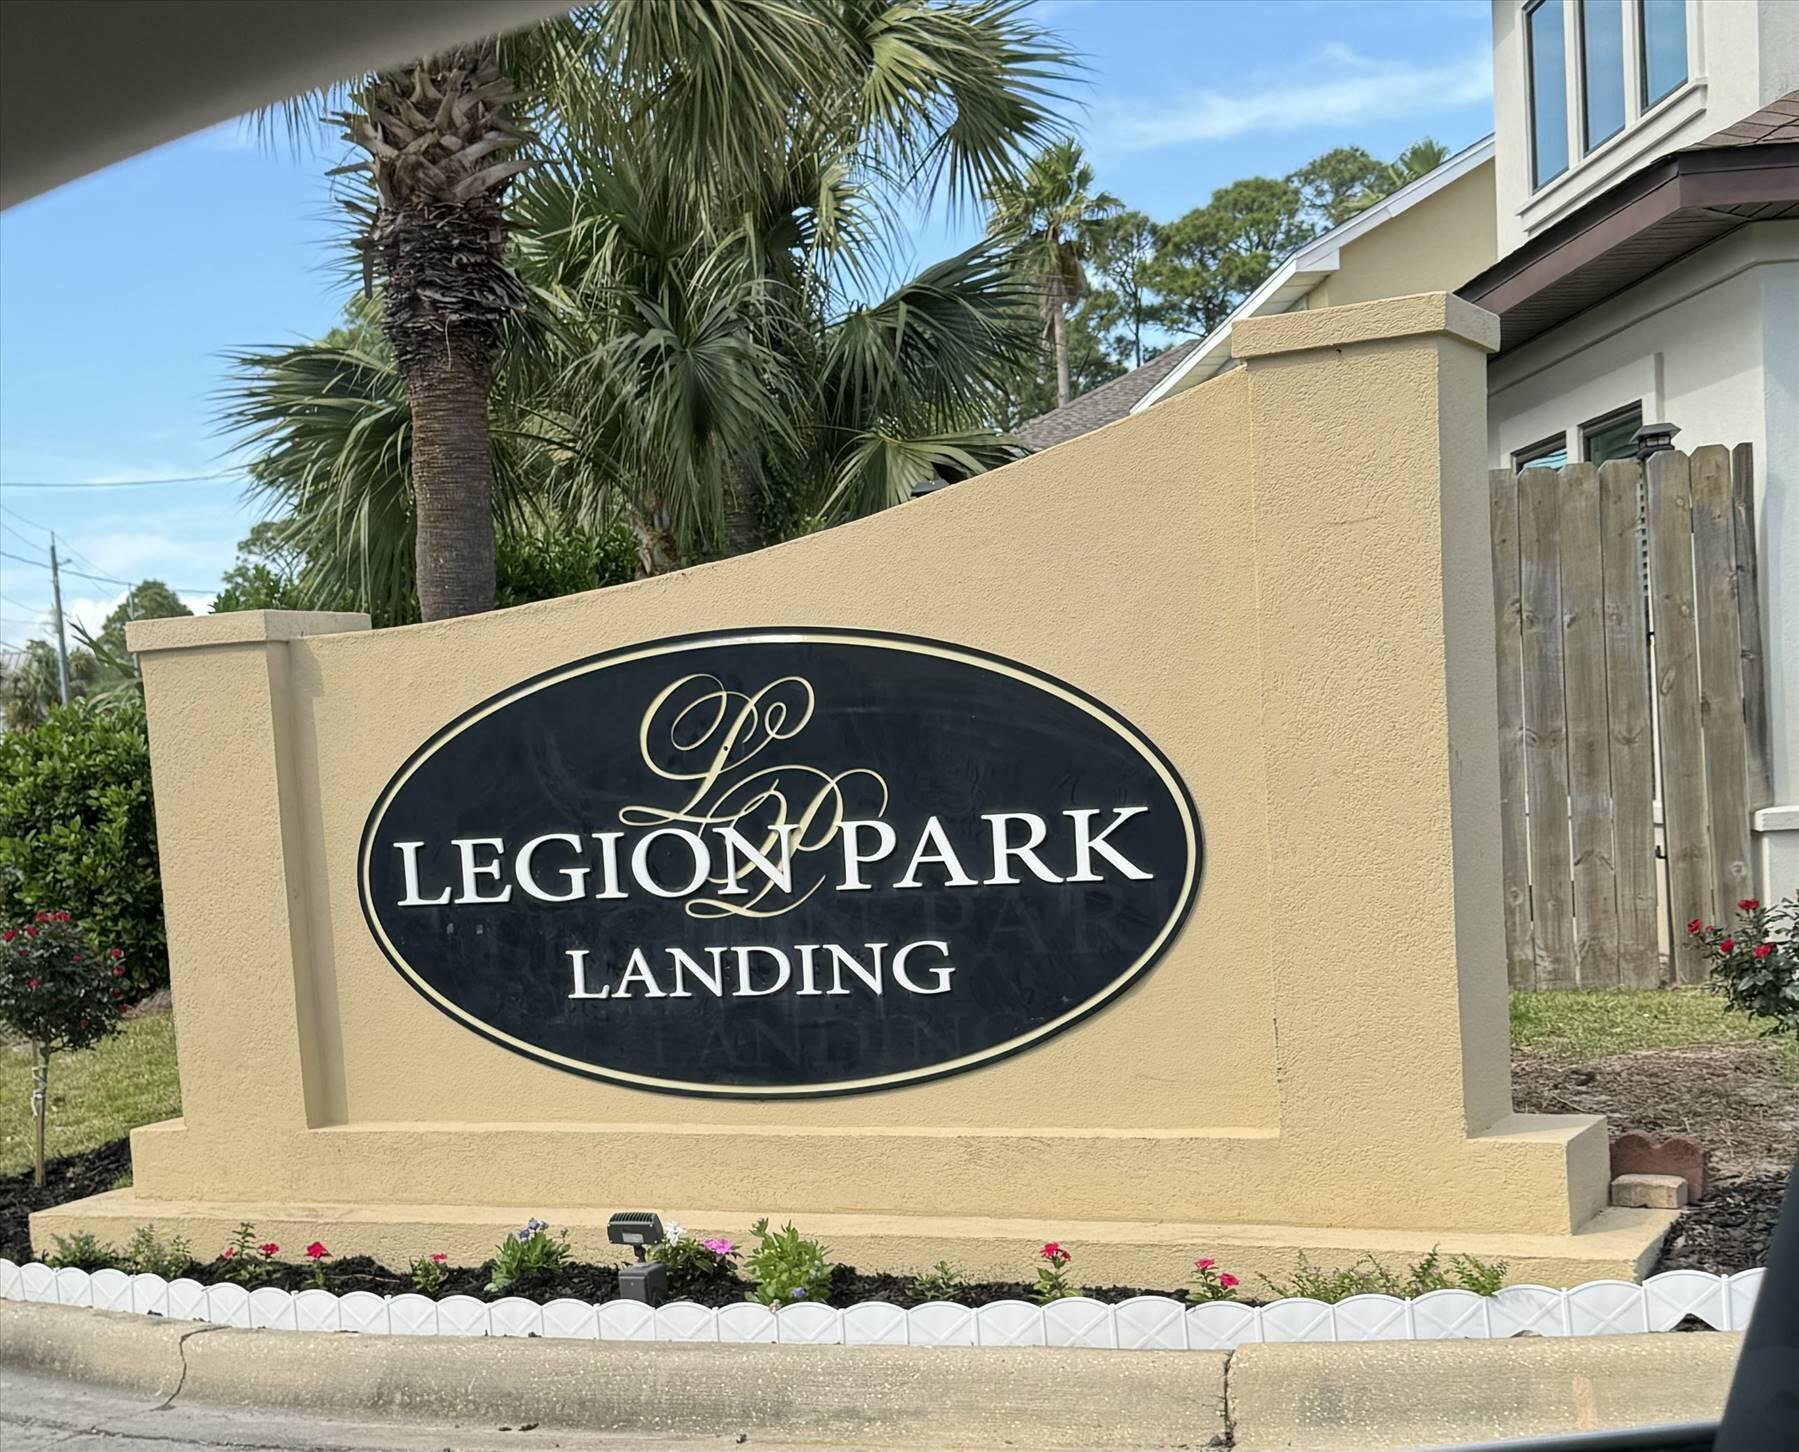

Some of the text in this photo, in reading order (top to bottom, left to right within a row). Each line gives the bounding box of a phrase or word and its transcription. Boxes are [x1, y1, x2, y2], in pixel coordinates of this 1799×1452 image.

[393, 806, 1154, 906] LEGION PARK
[565, 941, 957, 999] LANDING
